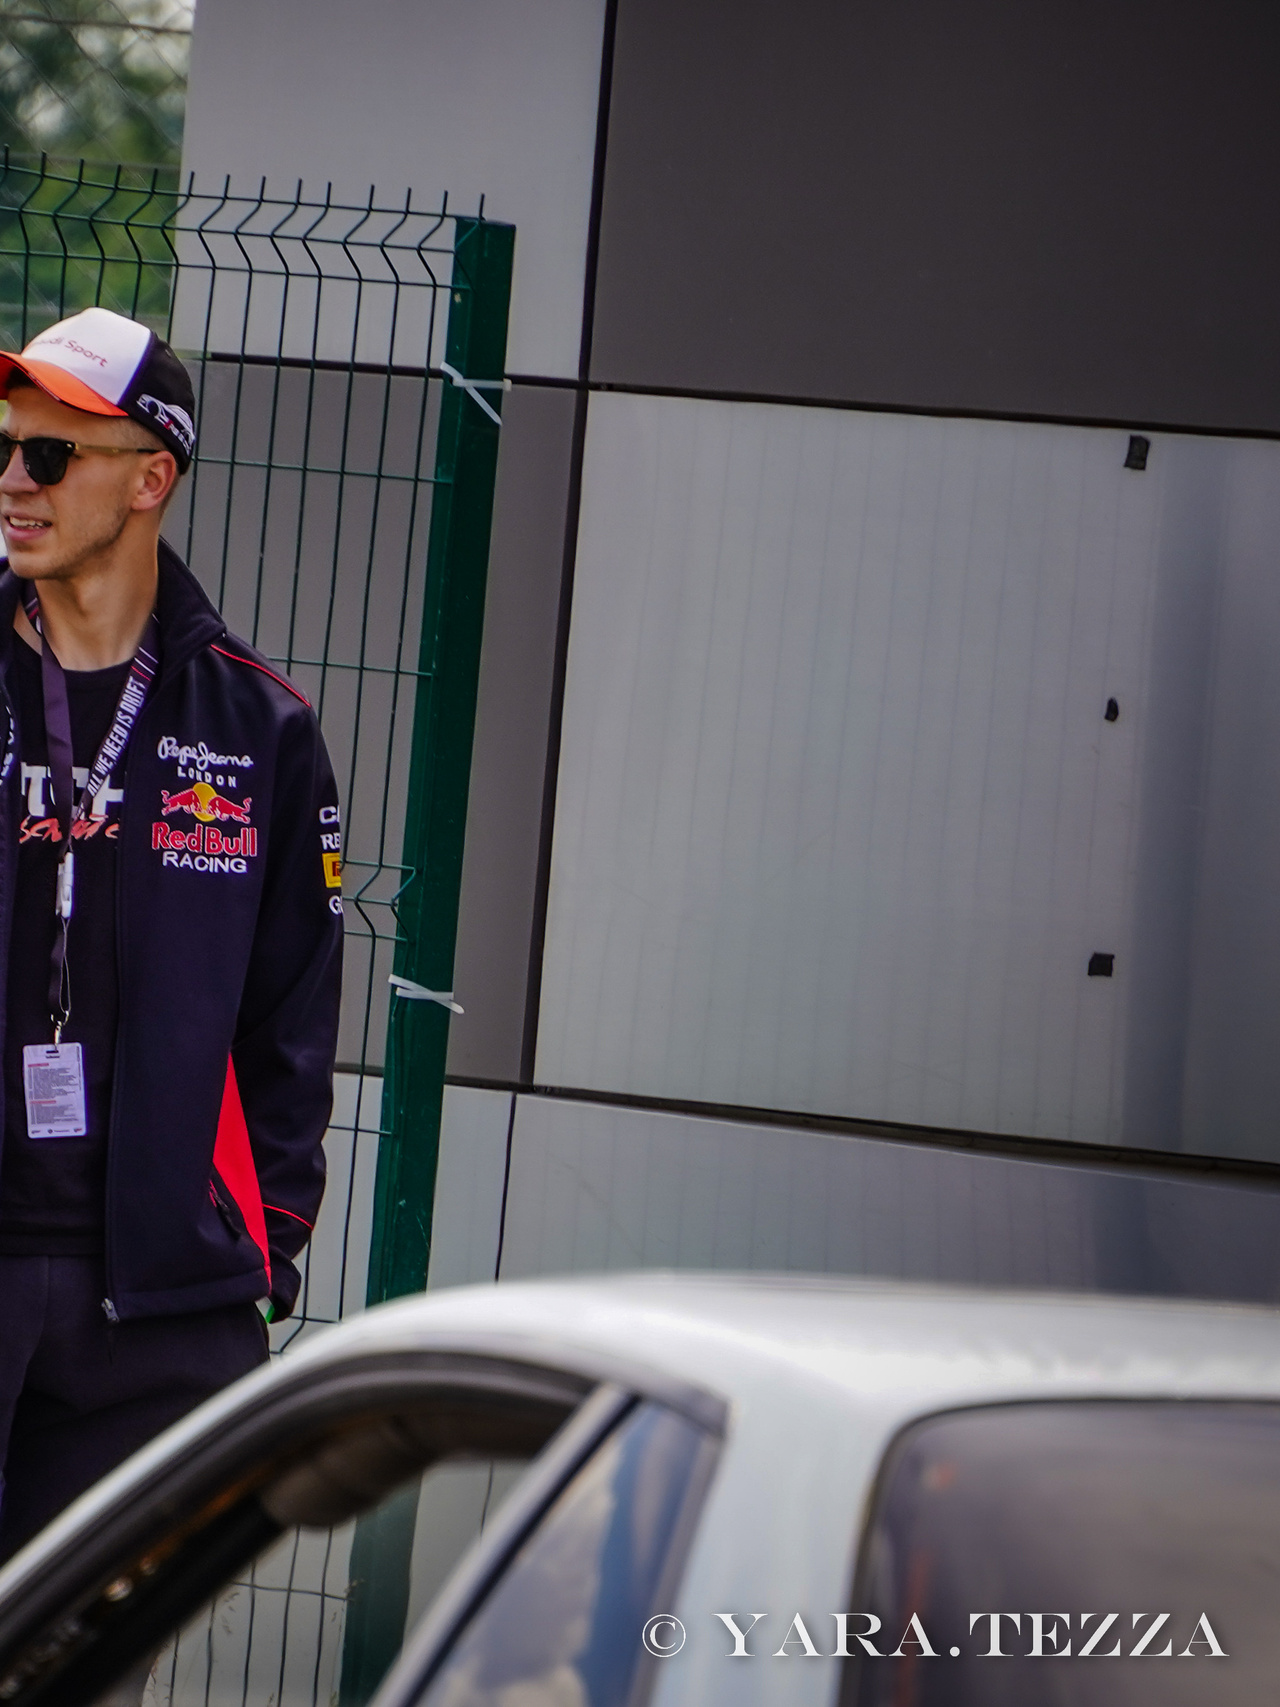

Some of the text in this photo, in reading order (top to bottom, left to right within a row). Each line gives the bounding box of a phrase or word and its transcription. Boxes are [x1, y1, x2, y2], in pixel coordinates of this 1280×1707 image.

[64, 339, 108, 368] Sport
[87, 675, 147, 797] ALL WE NEED IS DRIFT
[157, 736, 254, 771] Pepe Jeans
[177, 766, 237, 788] LONDON
[151, 821, 204, 854] Red
[205, 826, 258, 857] Bull
[162, 850, 248, 874] RACING
